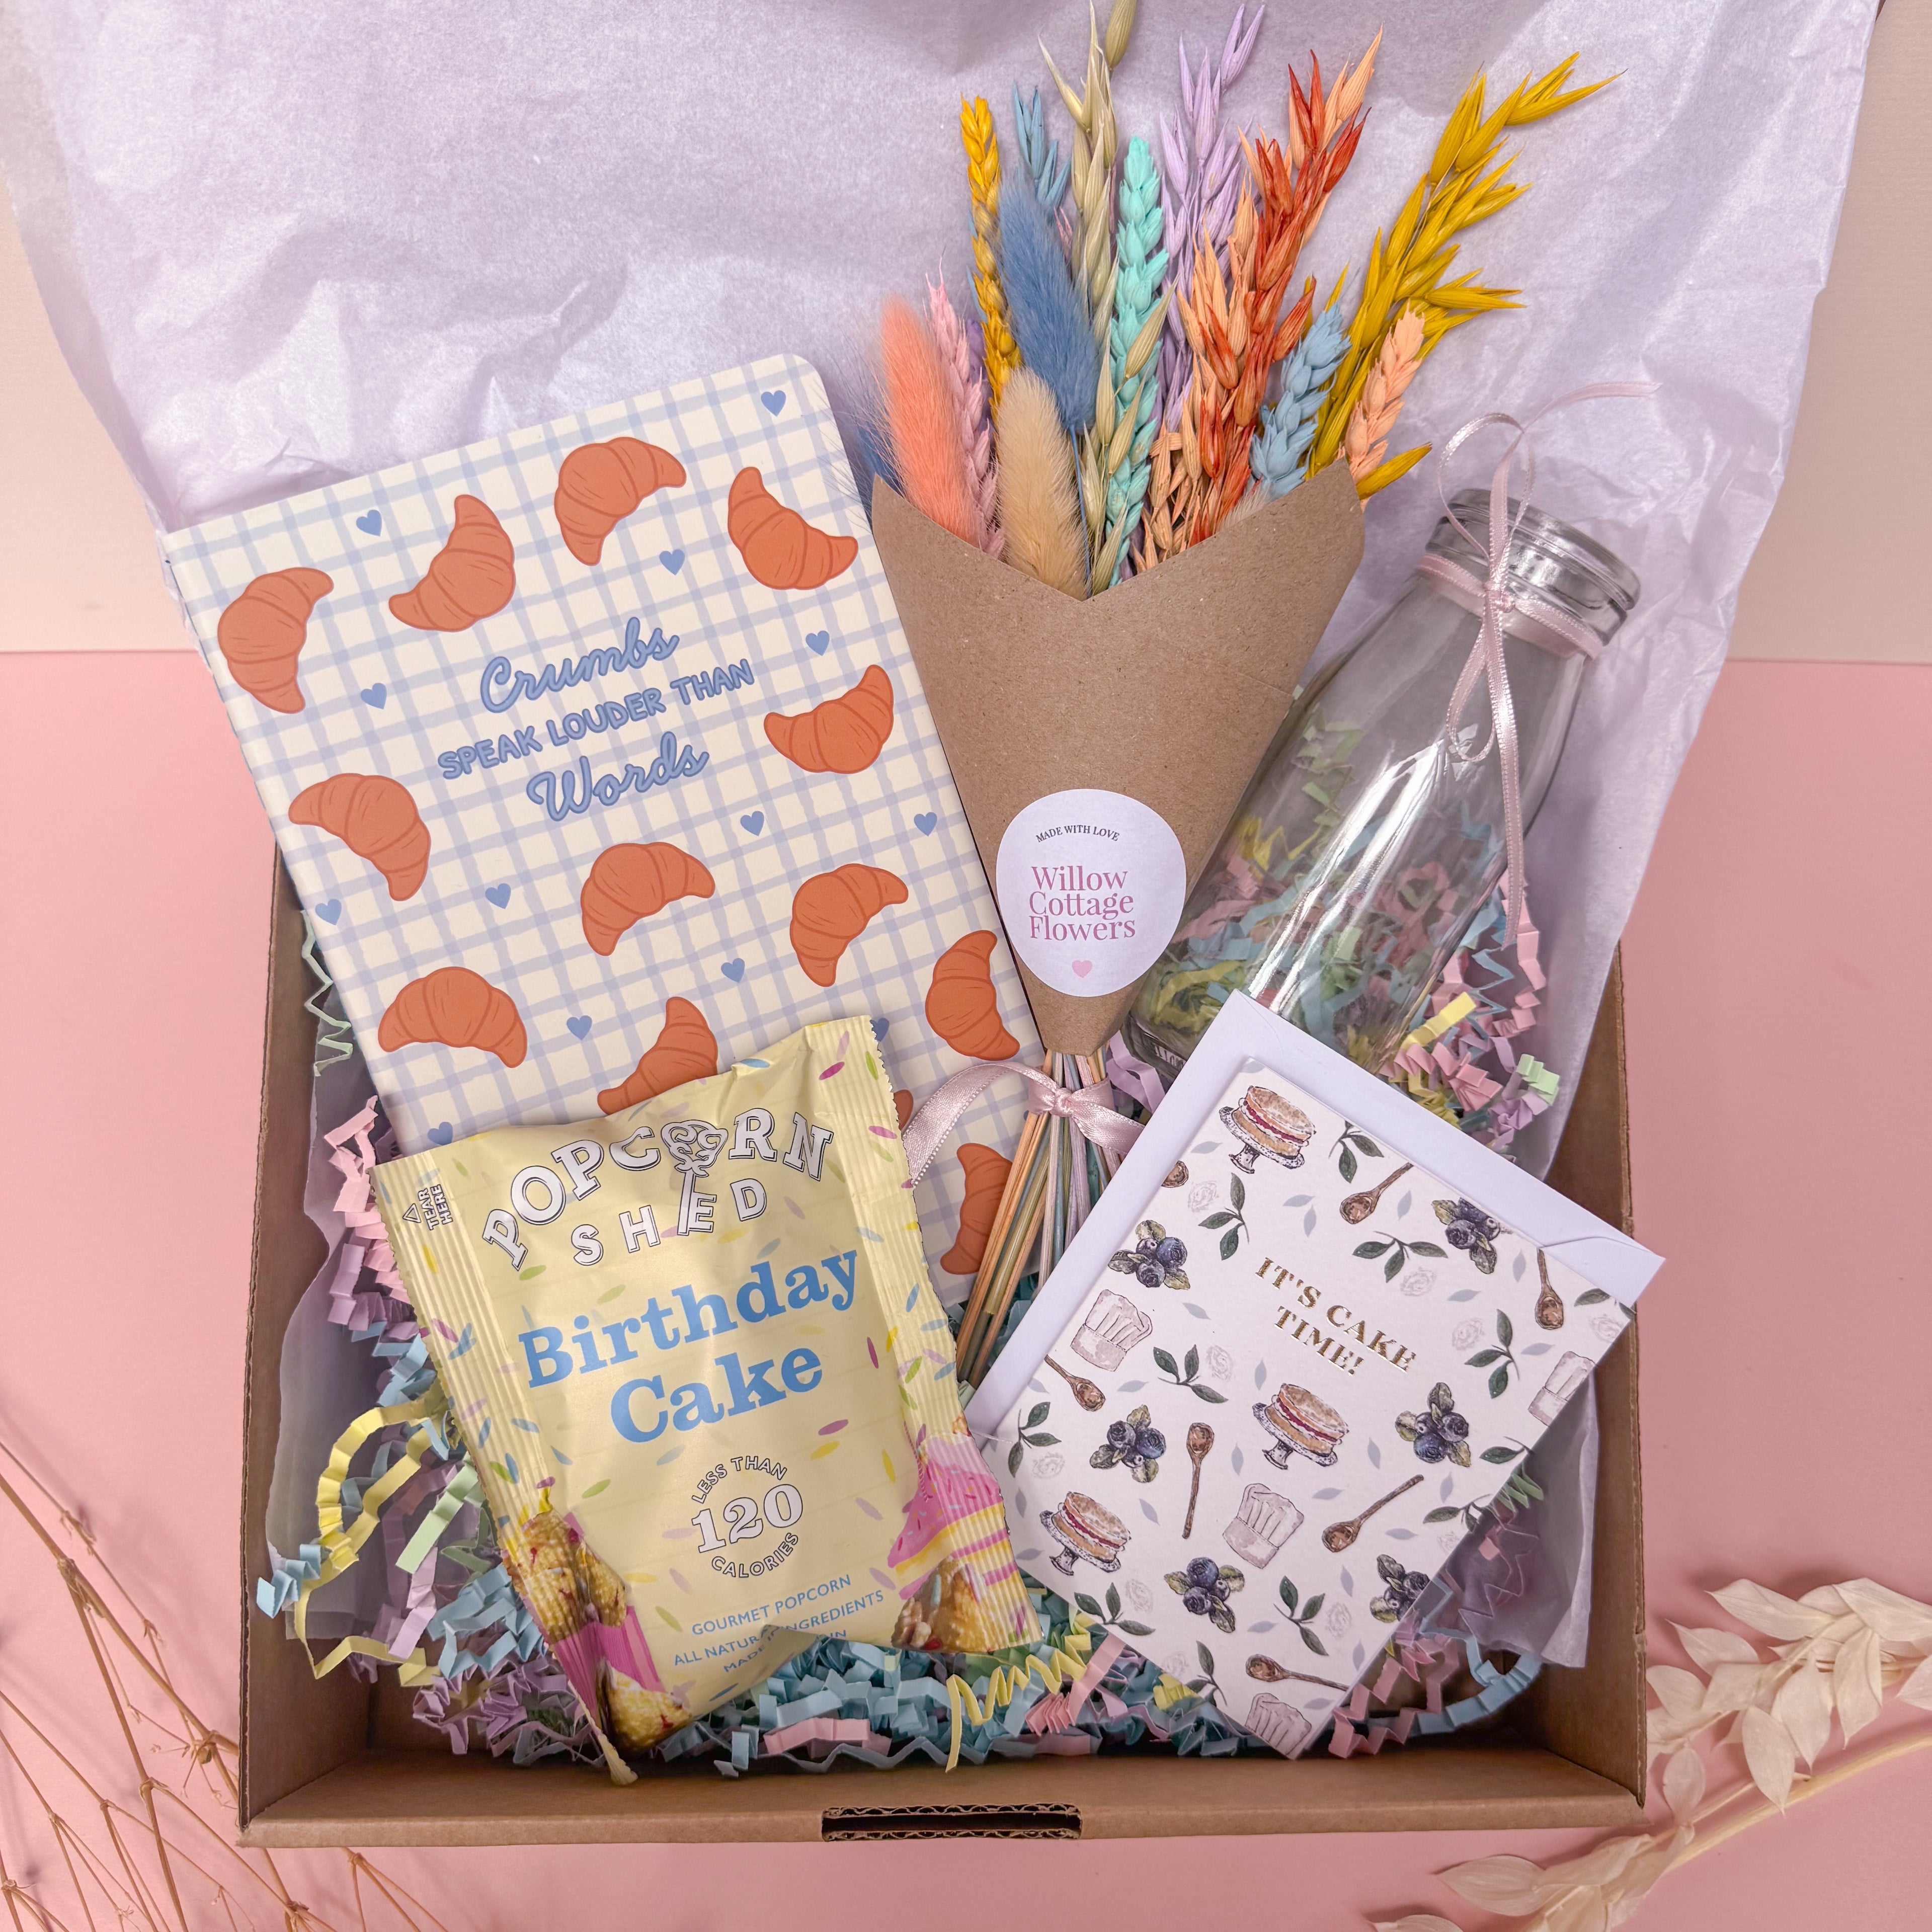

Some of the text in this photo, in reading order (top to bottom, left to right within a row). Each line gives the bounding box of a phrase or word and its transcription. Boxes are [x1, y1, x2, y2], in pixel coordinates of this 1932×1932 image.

[480, 617, 680, 713] Crumbs
[438, 659, 755, 780] SPEAK LOUDER THAN
[526, 732, 710, 822] Words
[1035, 824, 1120, 843] MADE WITH LOVE
[1029, 891, 1134, 920] Cottage
[1031, 865, 1129, 892] Willow
[1029, 915, 1136, 941] Flowers
[418, 1187, 439, 1231] TEAR
[430, 1184, 453, 1225] HERE
[571, 1178, 767, 1266] SHED
[518, 1249, 858, 1389] Birthday
[1255, 1257, 1417, 1374] IT'S CAKE
[1274, 1305, 1364, 1377] TIME!
[610, 1347, 823, 1443] Cake
[692, 1456, 787, 1504] LESS THAN
[691, 1484, 803, 1554] 120
[711, 1532, 798, 1578] CALORIES
[674, 1651, 702, 1666] ALL
[781, 1590, 884, 1631] NGREDIENTS
[692, 1574, 851, 1635] GOURMET POPCORN
